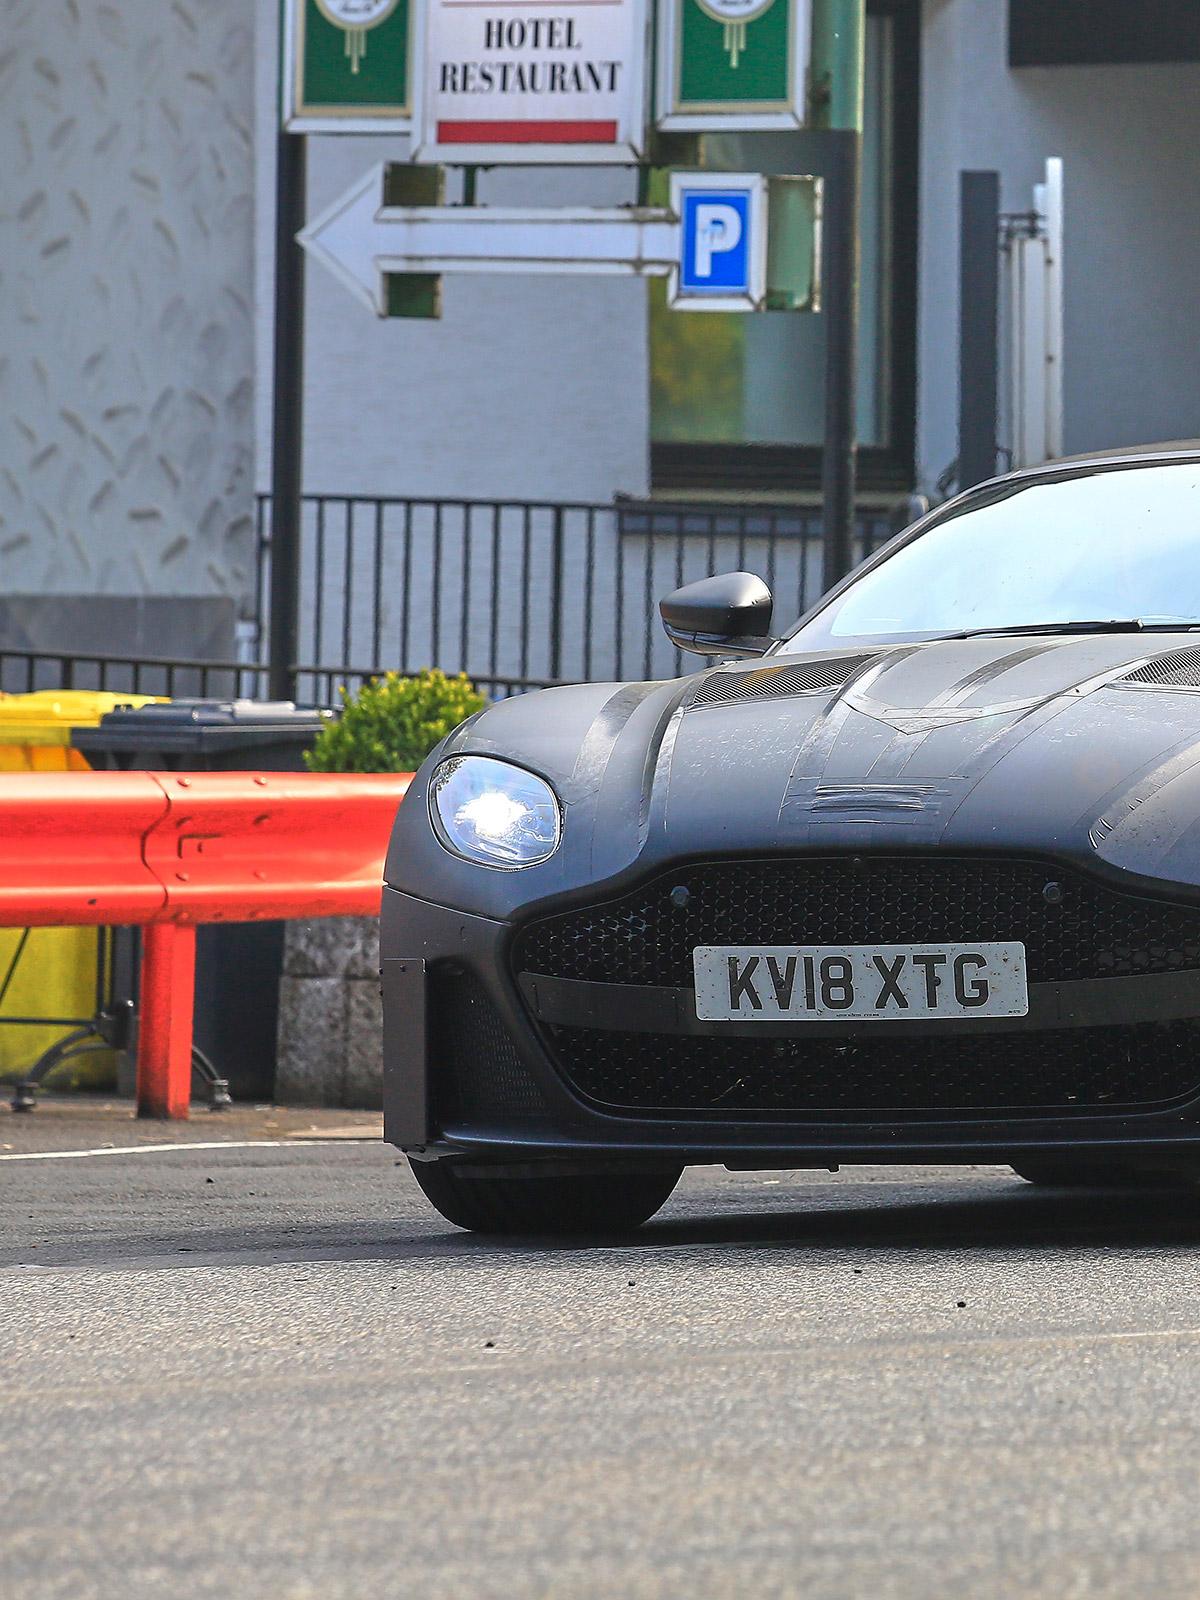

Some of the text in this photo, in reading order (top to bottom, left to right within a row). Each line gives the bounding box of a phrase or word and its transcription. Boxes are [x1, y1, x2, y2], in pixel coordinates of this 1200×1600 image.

[483, 18, 582, 51] HOTEL
[439, 61, 623, 94] RESTAURANT
[694, 203, 742, 278] P
[727, 953, 990, 1011] KV18 XTG
